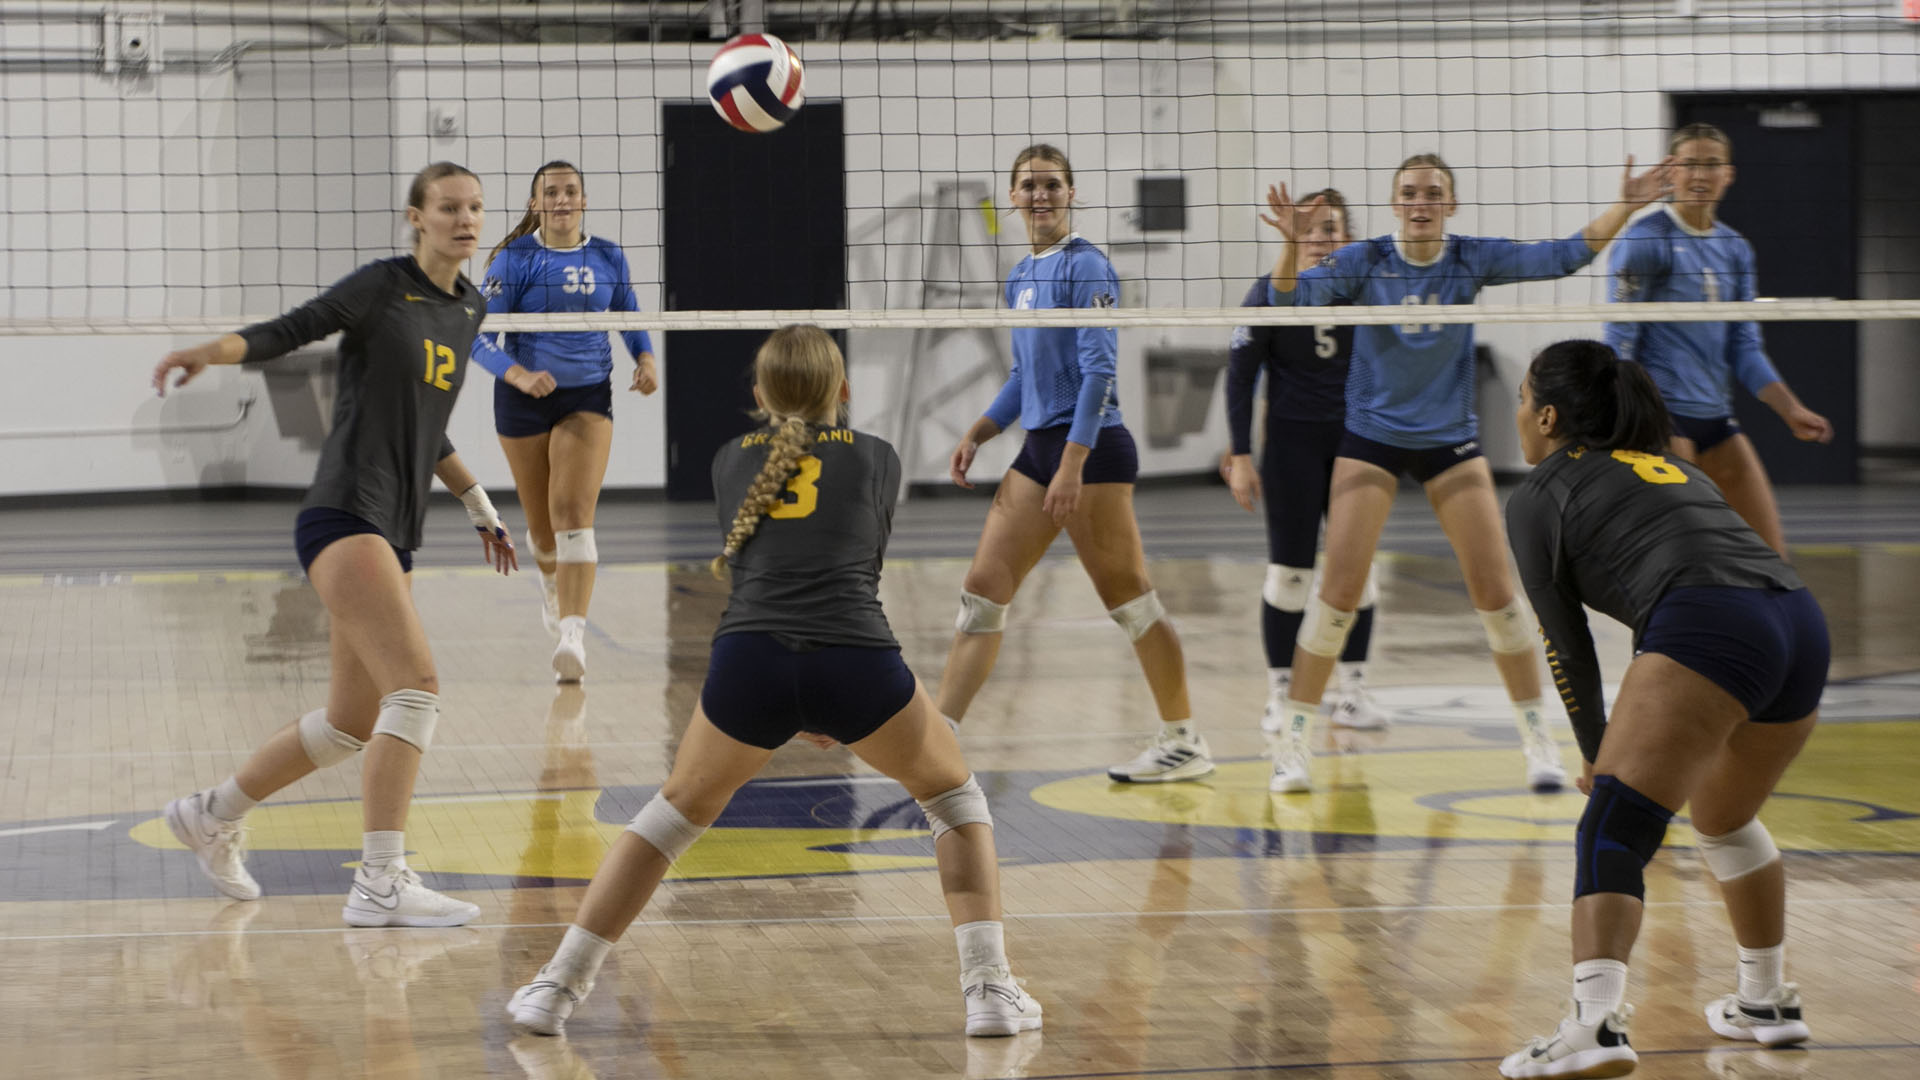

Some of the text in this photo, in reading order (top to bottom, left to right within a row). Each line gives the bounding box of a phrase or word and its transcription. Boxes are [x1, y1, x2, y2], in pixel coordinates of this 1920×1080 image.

[562, 265, 596, 295] 33
[1313, 324, 1338, 359] 5
[423, 338, 457, 392] 12
[741, 429, 854, 449] GRAND
[1611, 449, 1688, 485] 8
[767, 455, 822, 519] 3
